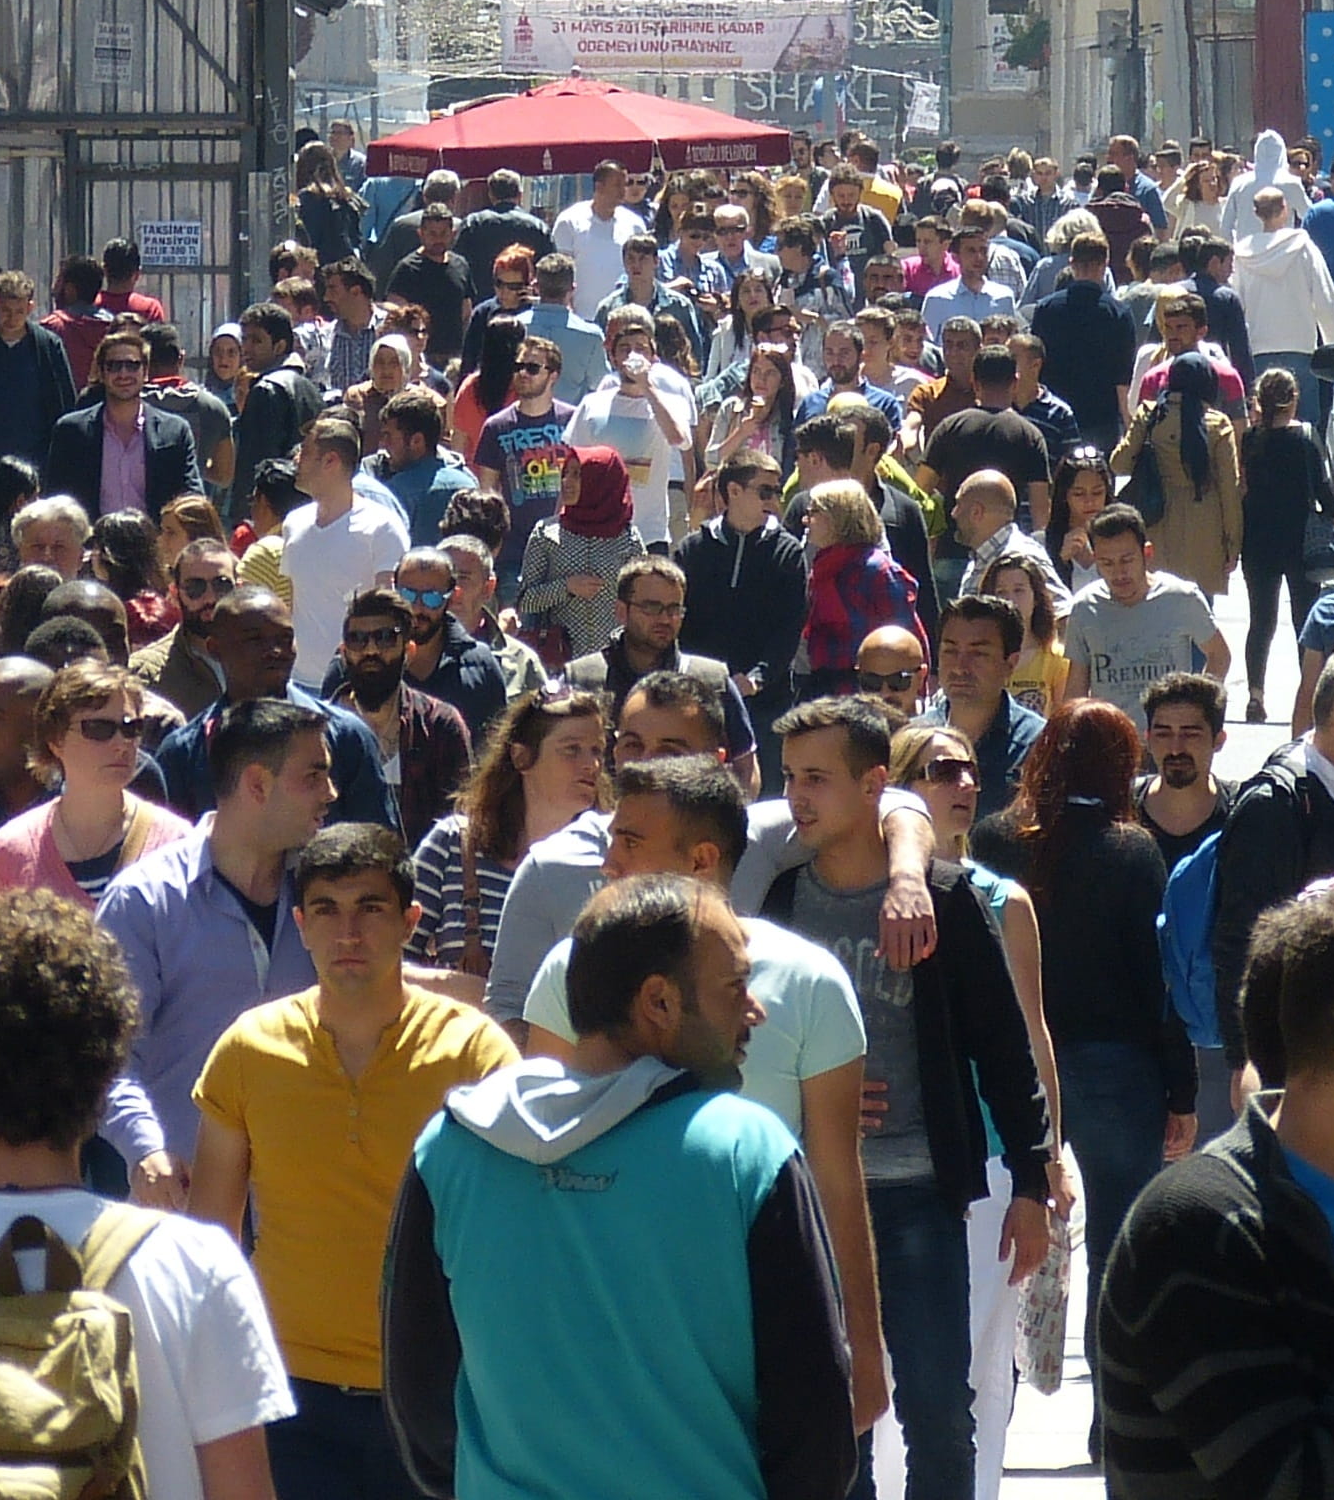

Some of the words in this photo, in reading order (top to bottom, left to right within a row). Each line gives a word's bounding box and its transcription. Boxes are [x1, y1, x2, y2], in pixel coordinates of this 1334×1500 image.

[551, 20, 567, 35] 31
[571, 20, 614, 35] MAYIS
[718, 21, 765, 36] KADAR
